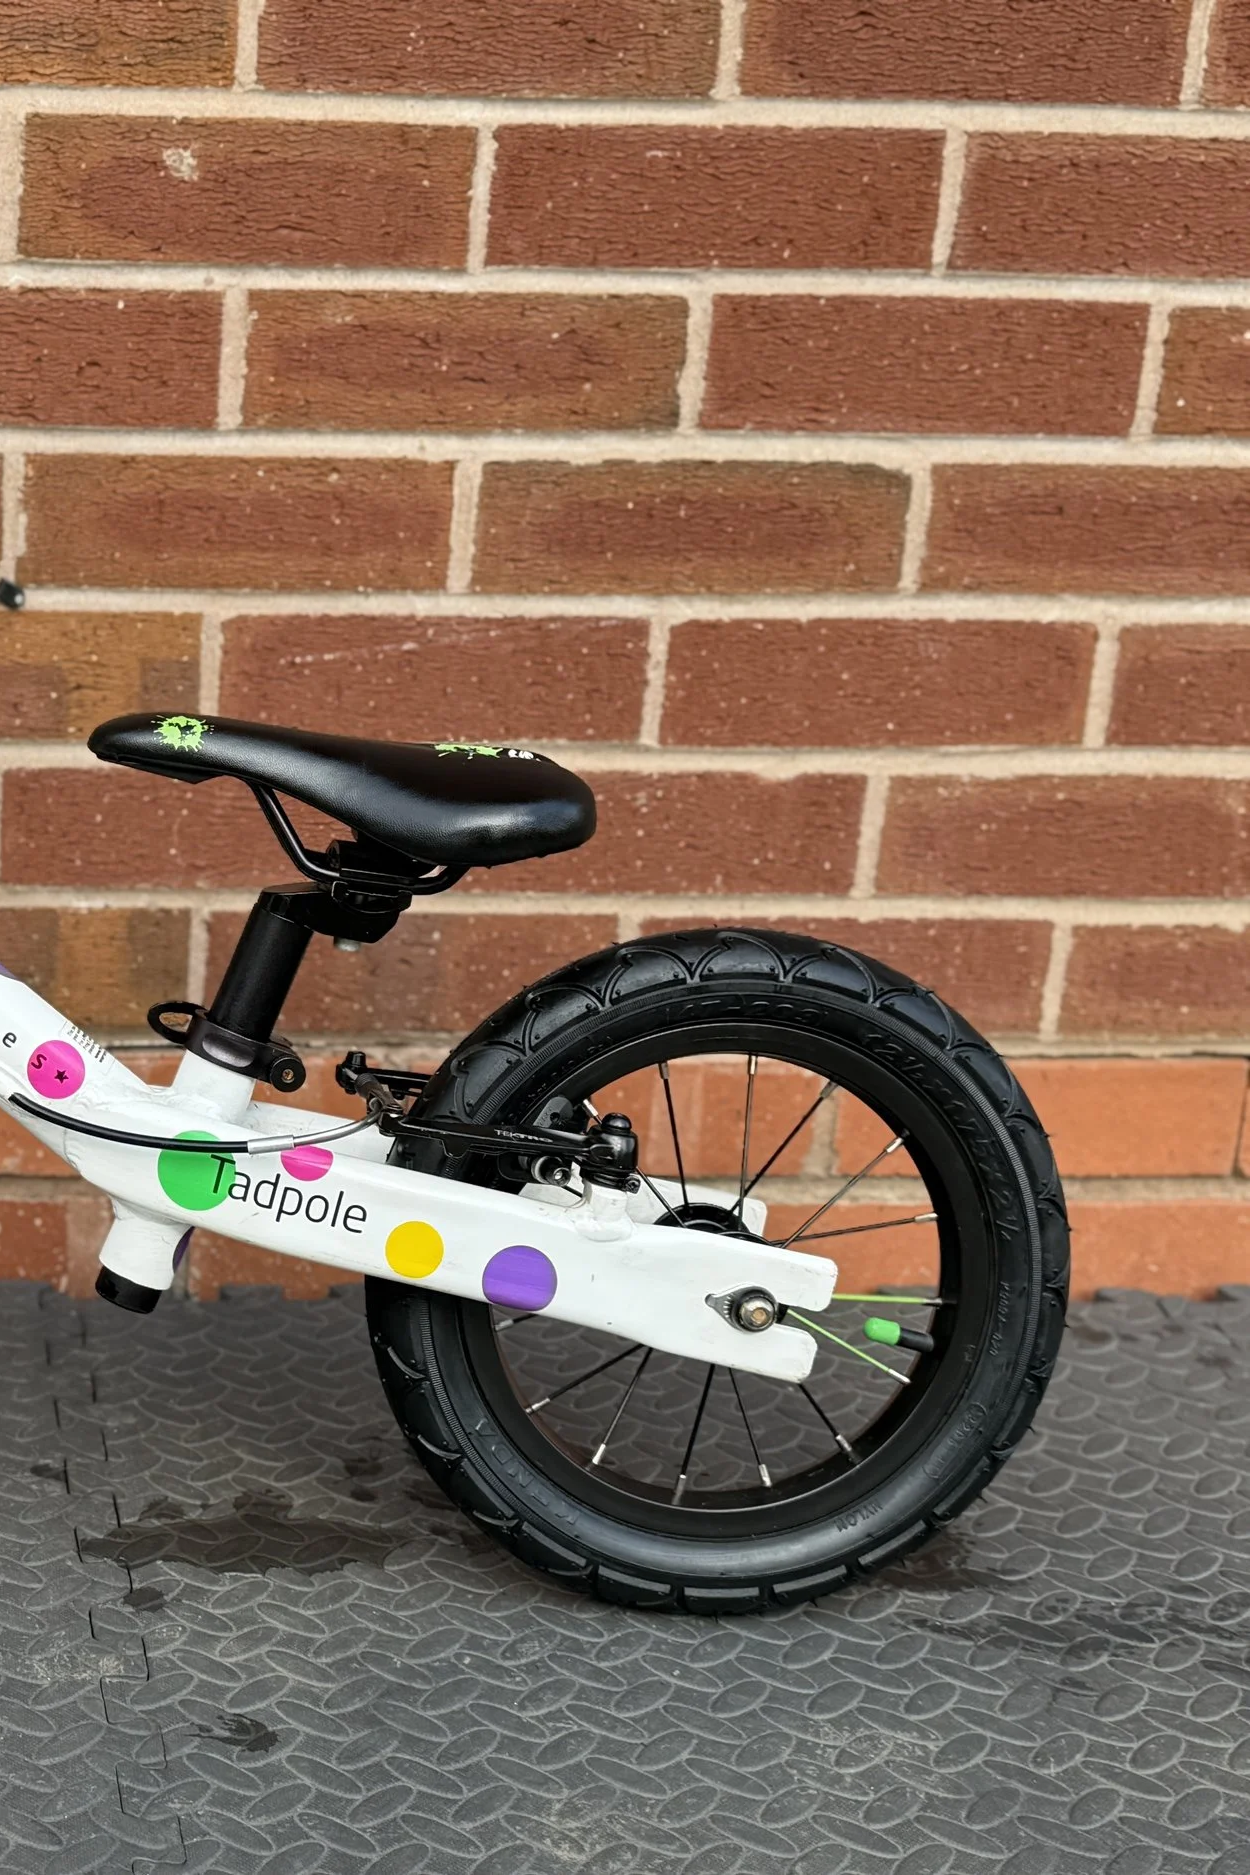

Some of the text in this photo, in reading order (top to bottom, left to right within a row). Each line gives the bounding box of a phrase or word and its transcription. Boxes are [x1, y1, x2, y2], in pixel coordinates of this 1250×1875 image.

[494, 1129, 554, 1143] TEKTRO
[210, 1154, 367, 1233] Tadpole
[474, 1418, 580, 1525] KENDA
